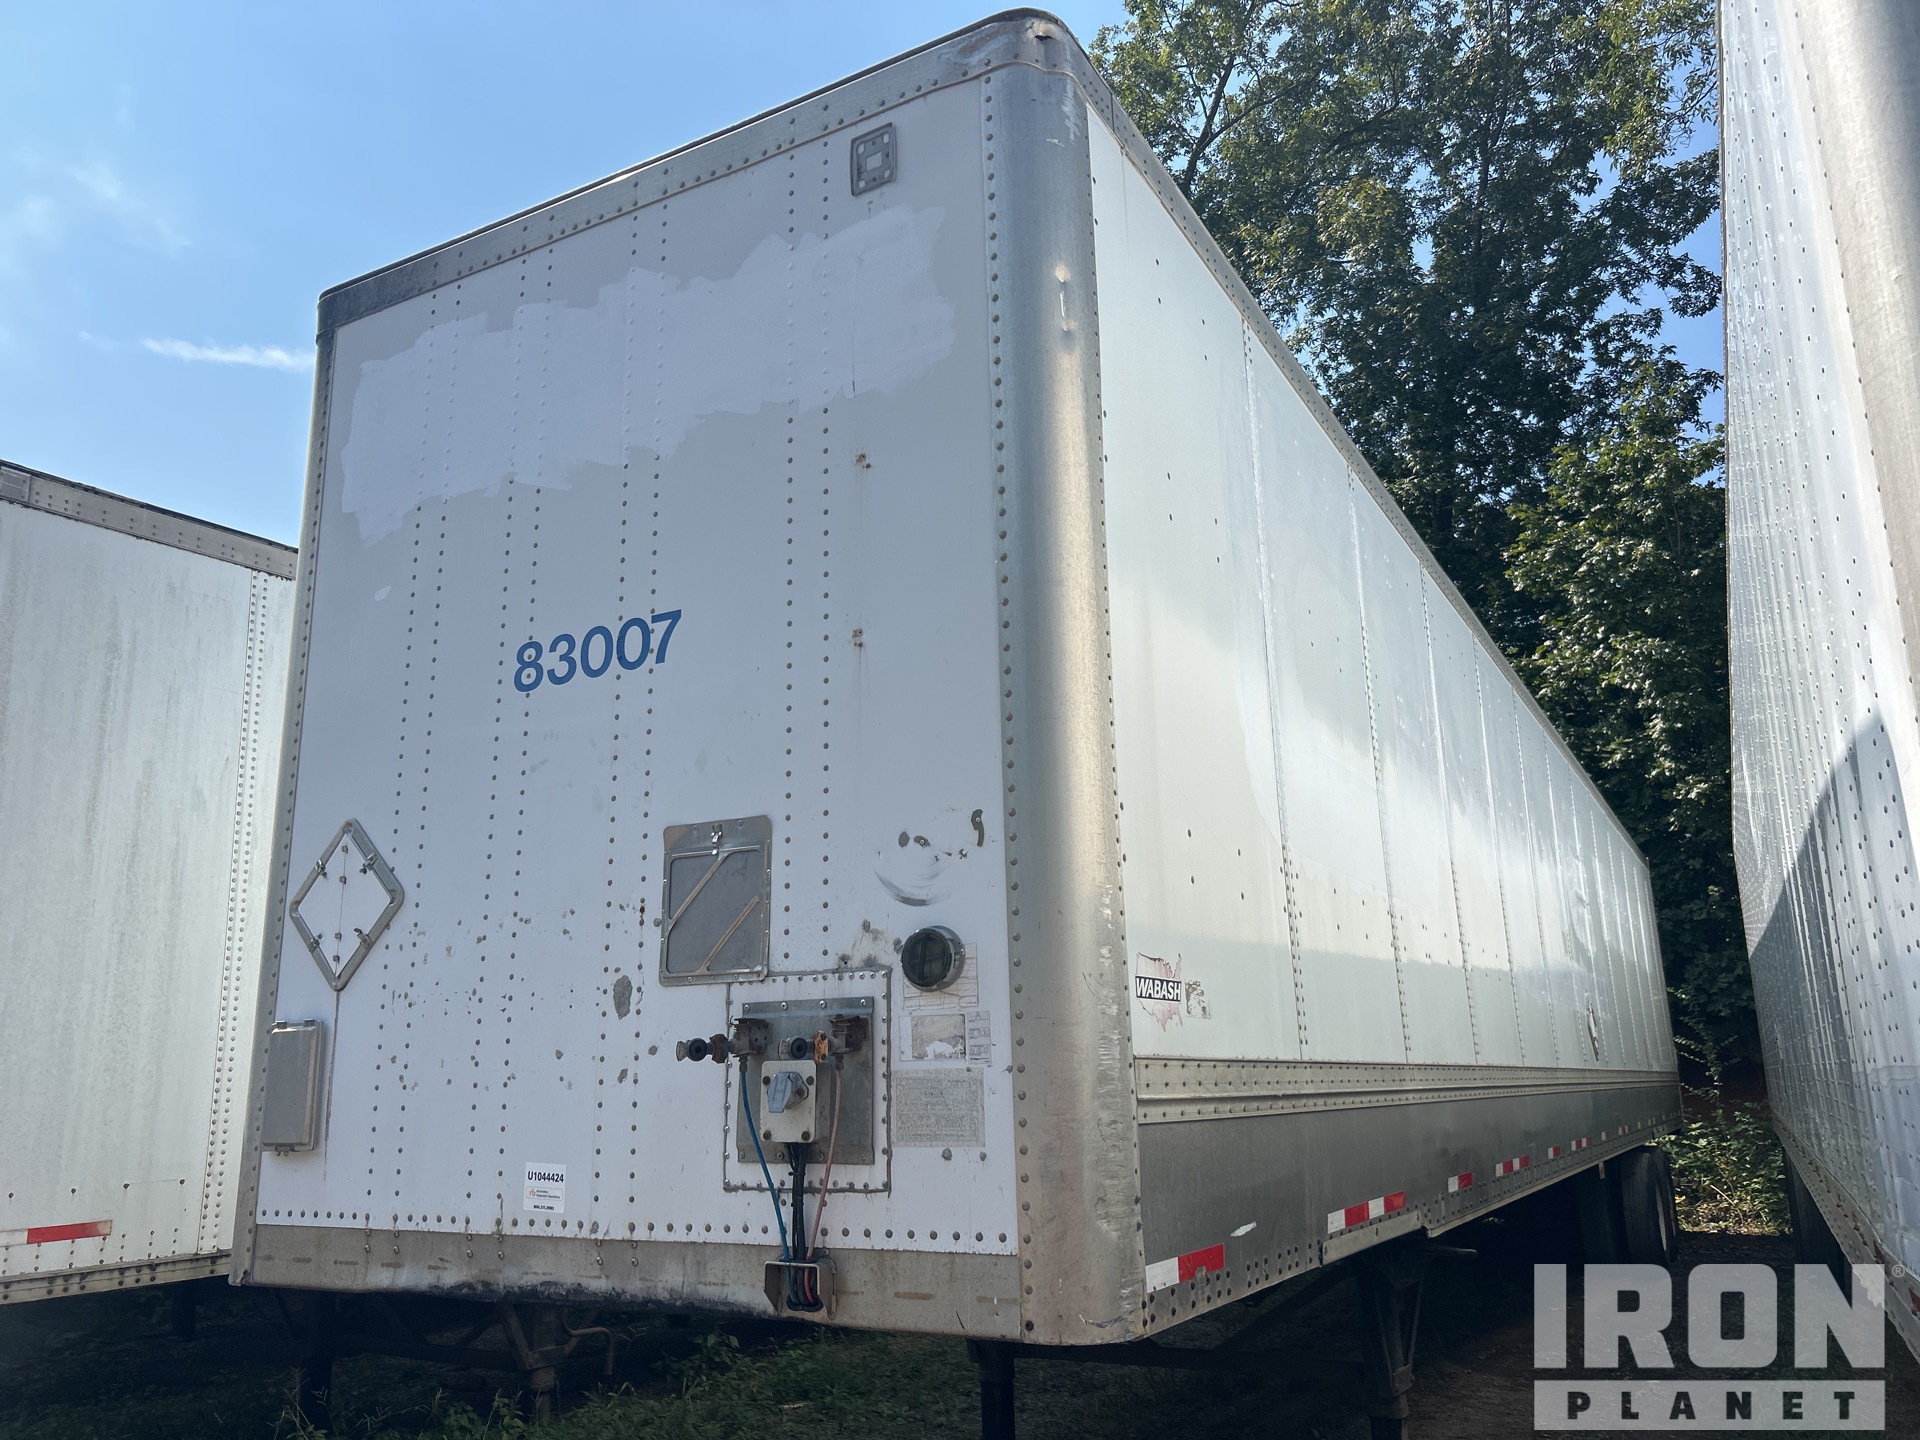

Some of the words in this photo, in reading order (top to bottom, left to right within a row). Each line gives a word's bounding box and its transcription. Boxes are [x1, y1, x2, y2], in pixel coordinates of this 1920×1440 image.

[513, 609, 682, 693] 83007
[1136, 977, 1181, 1001] WABASH
[527, 1170, 565, 1183] U1044424
